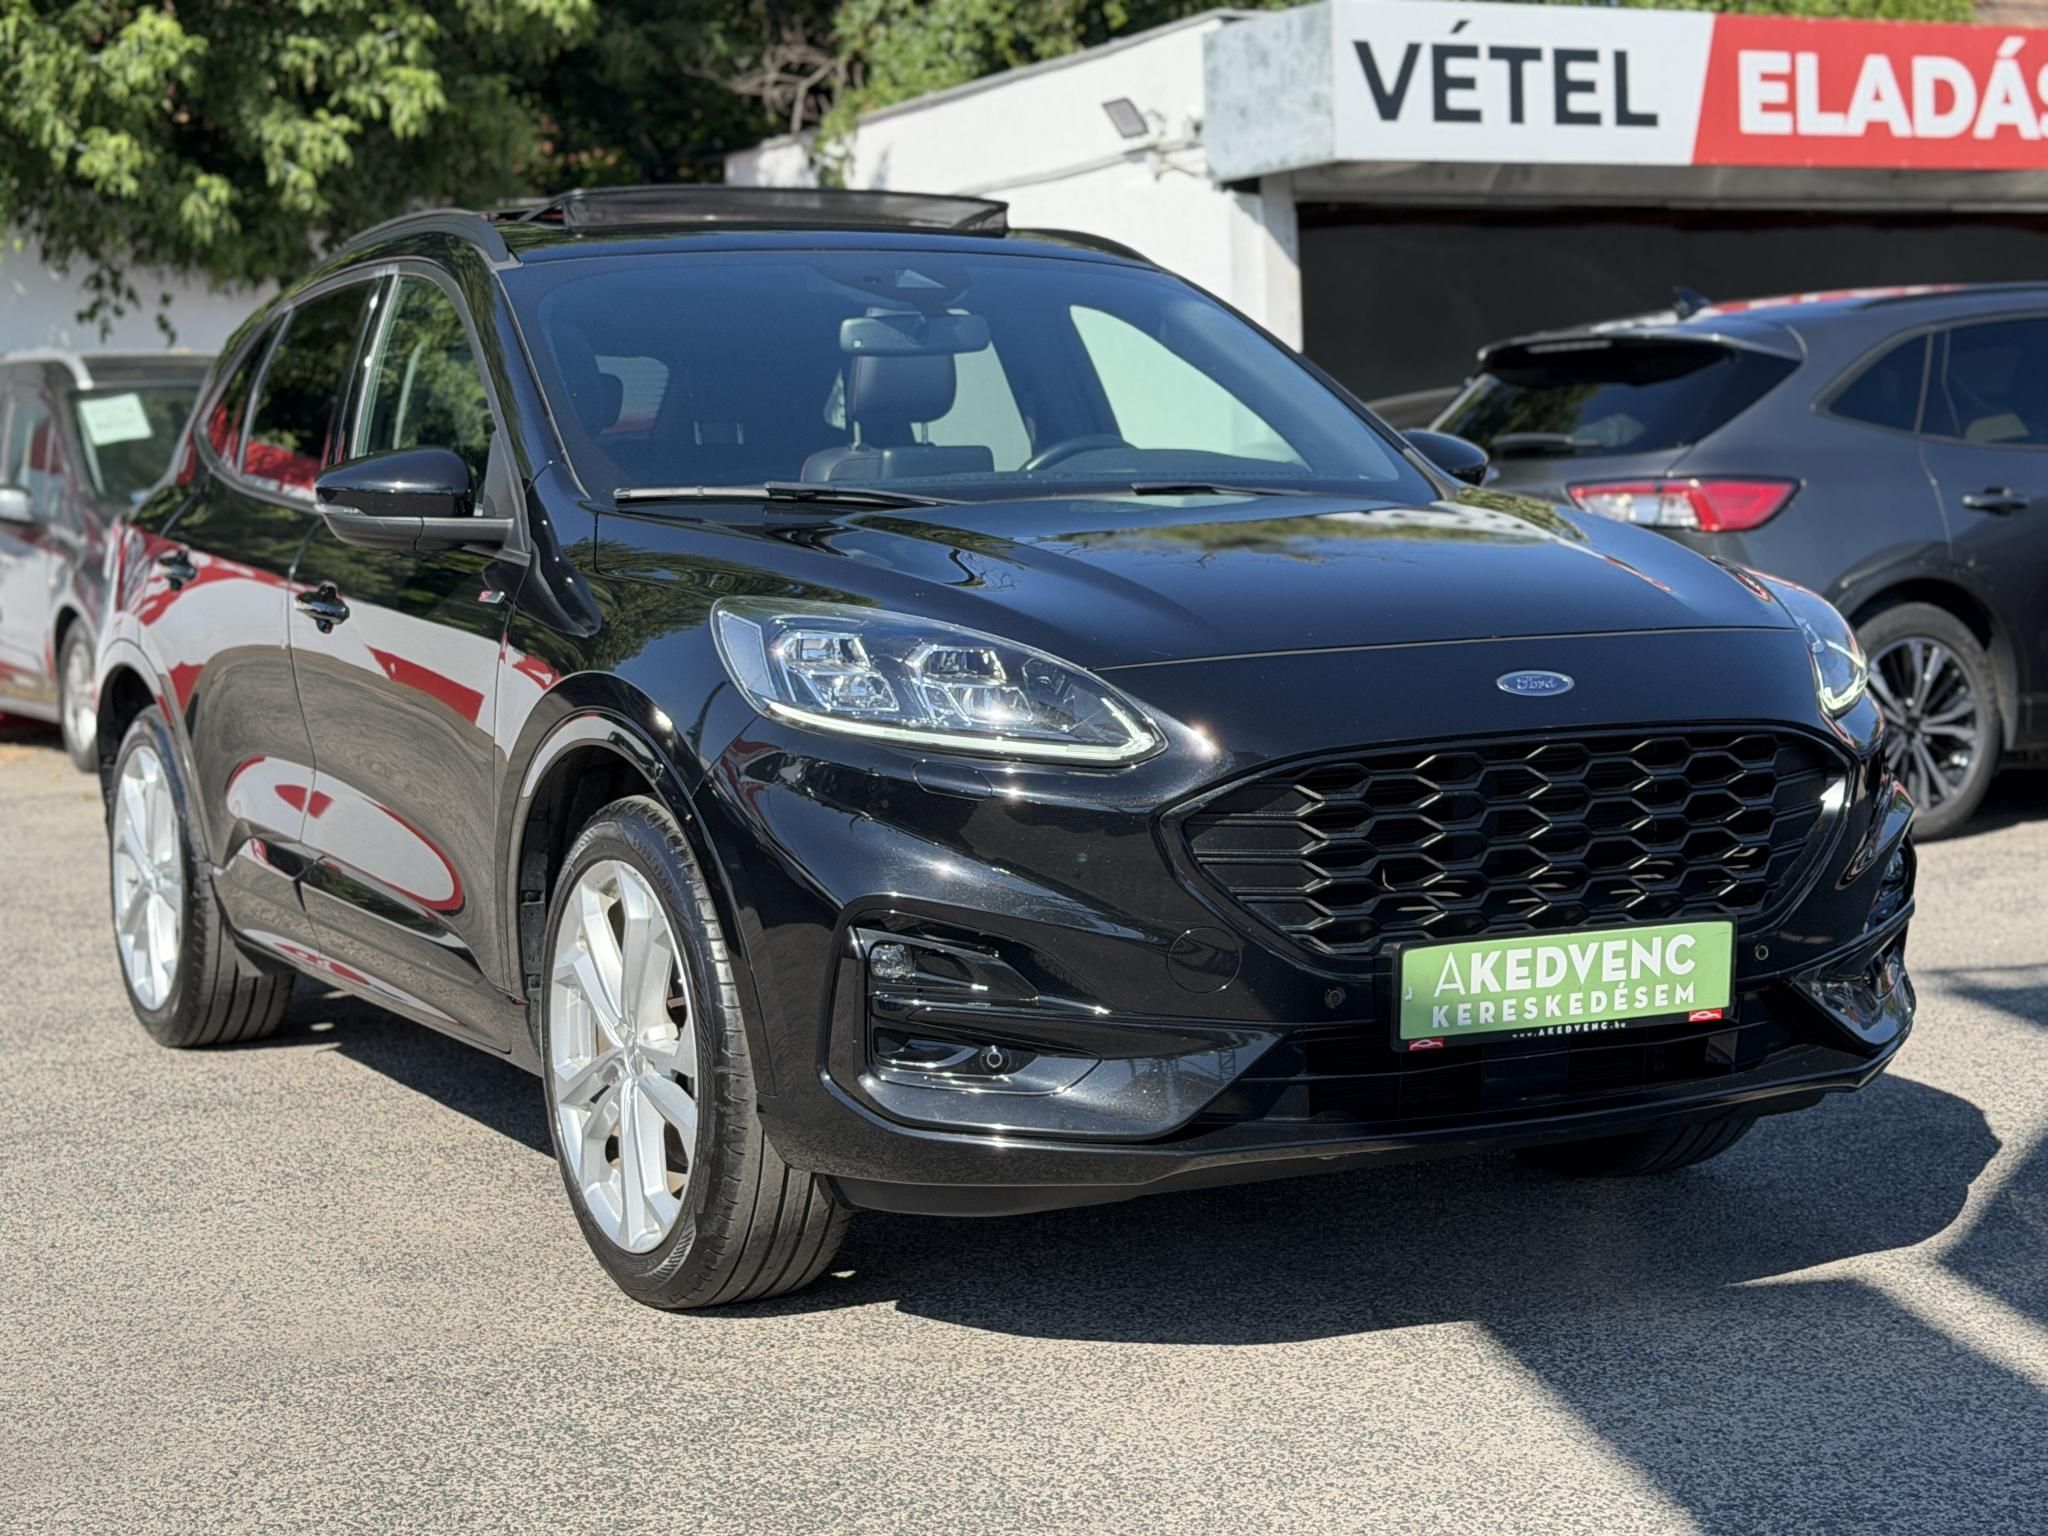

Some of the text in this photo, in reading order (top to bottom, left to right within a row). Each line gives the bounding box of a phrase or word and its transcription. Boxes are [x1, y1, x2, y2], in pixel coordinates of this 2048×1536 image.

[1352, 20, 2048, 140] VÉTEL ELADÁ
[1432, 982, 1695, 1028] KERESKEDÉSEM
